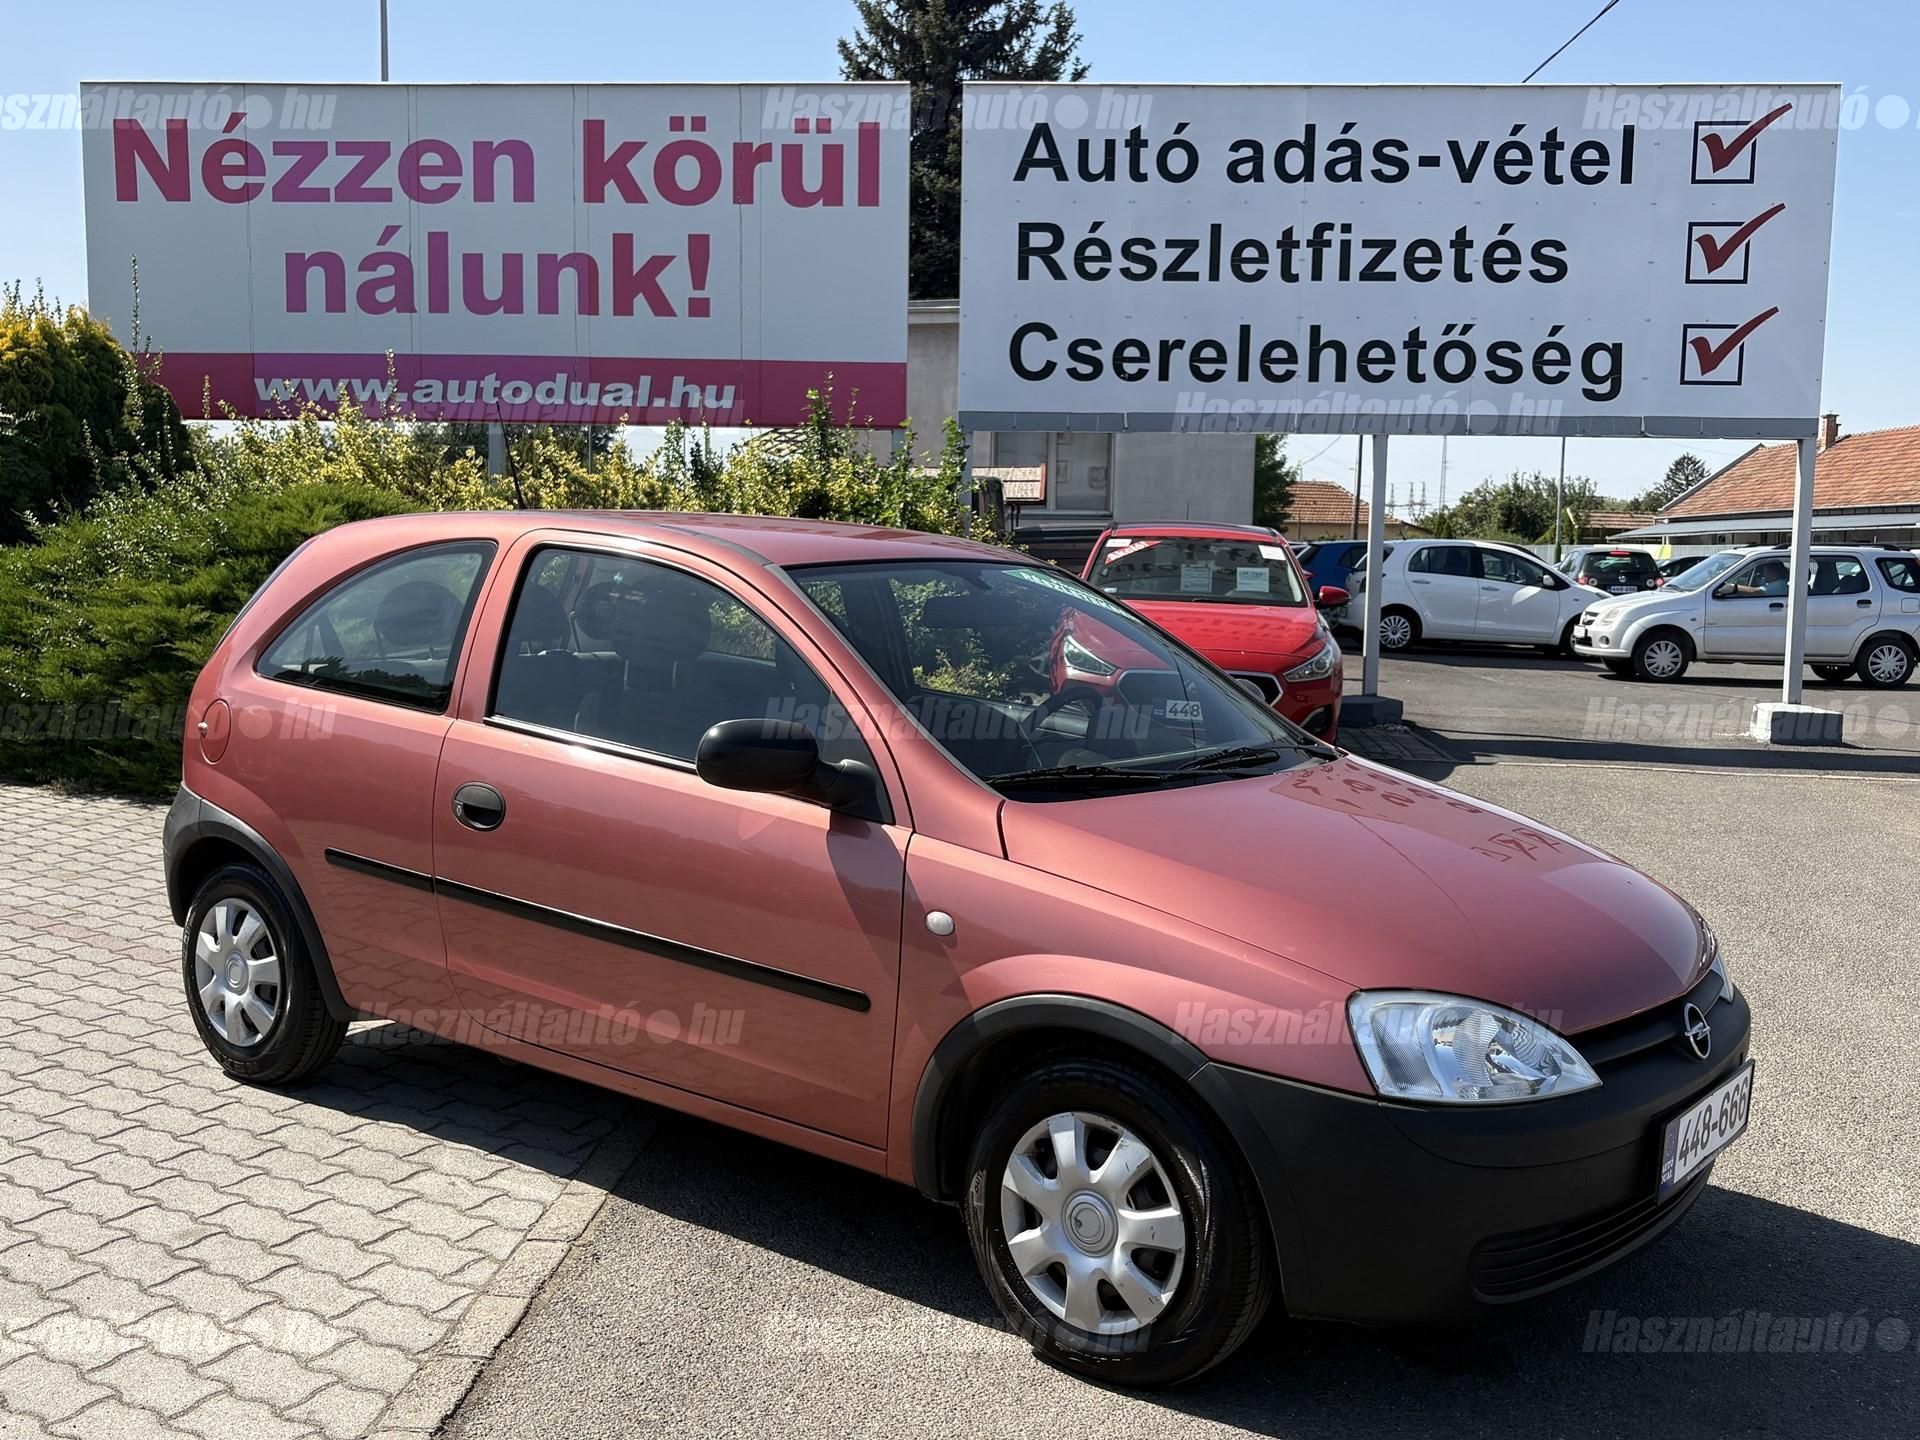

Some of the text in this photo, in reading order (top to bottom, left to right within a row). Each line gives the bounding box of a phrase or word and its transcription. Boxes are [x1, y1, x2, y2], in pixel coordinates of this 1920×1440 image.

[112, 111, 880, 207] Nézzen körül
[1013, 122, 1635, 186] Autó adás-vétel
[285, 226, 711, 317] nálunk!
[1017, 220, 1569, 284] Részletfizetés
[254, 373, 735, 409] www.autodual.hu
[1009, 321, 1624, 401] Cserelehetőség
[1169, 702, 1200, 717] 448
[1678, 1076, 1748, 1167] 448-666
